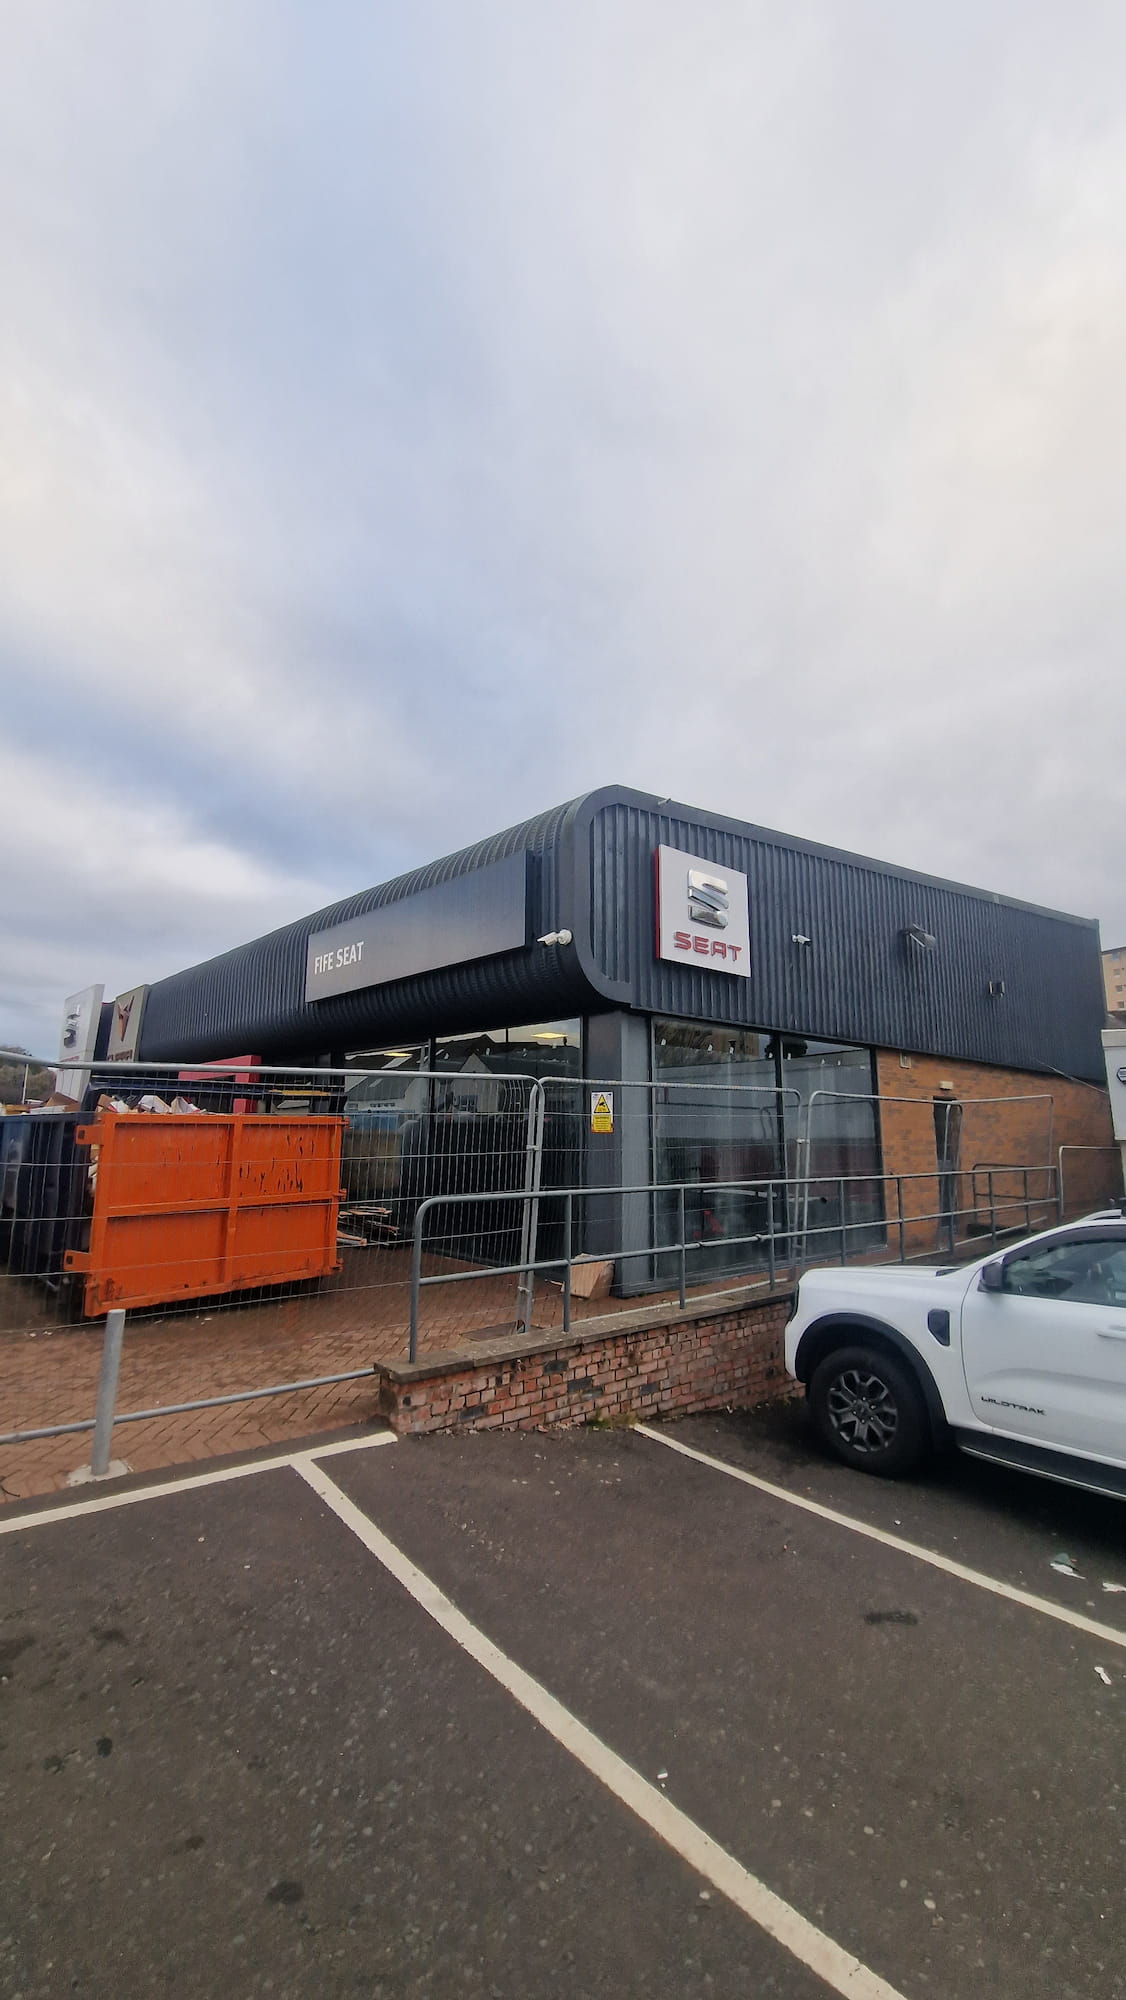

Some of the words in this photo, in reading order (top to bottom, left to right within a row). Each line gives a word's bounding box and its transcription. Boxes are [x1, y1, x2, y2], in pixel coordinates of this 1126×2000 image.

[314, 951, 334, 976] FIFE
[335, 940, 365, 969] SEAT
[674, 931, 742, 962] SEAT
[981, 1396, 1047, 1416] WILDTRAK
